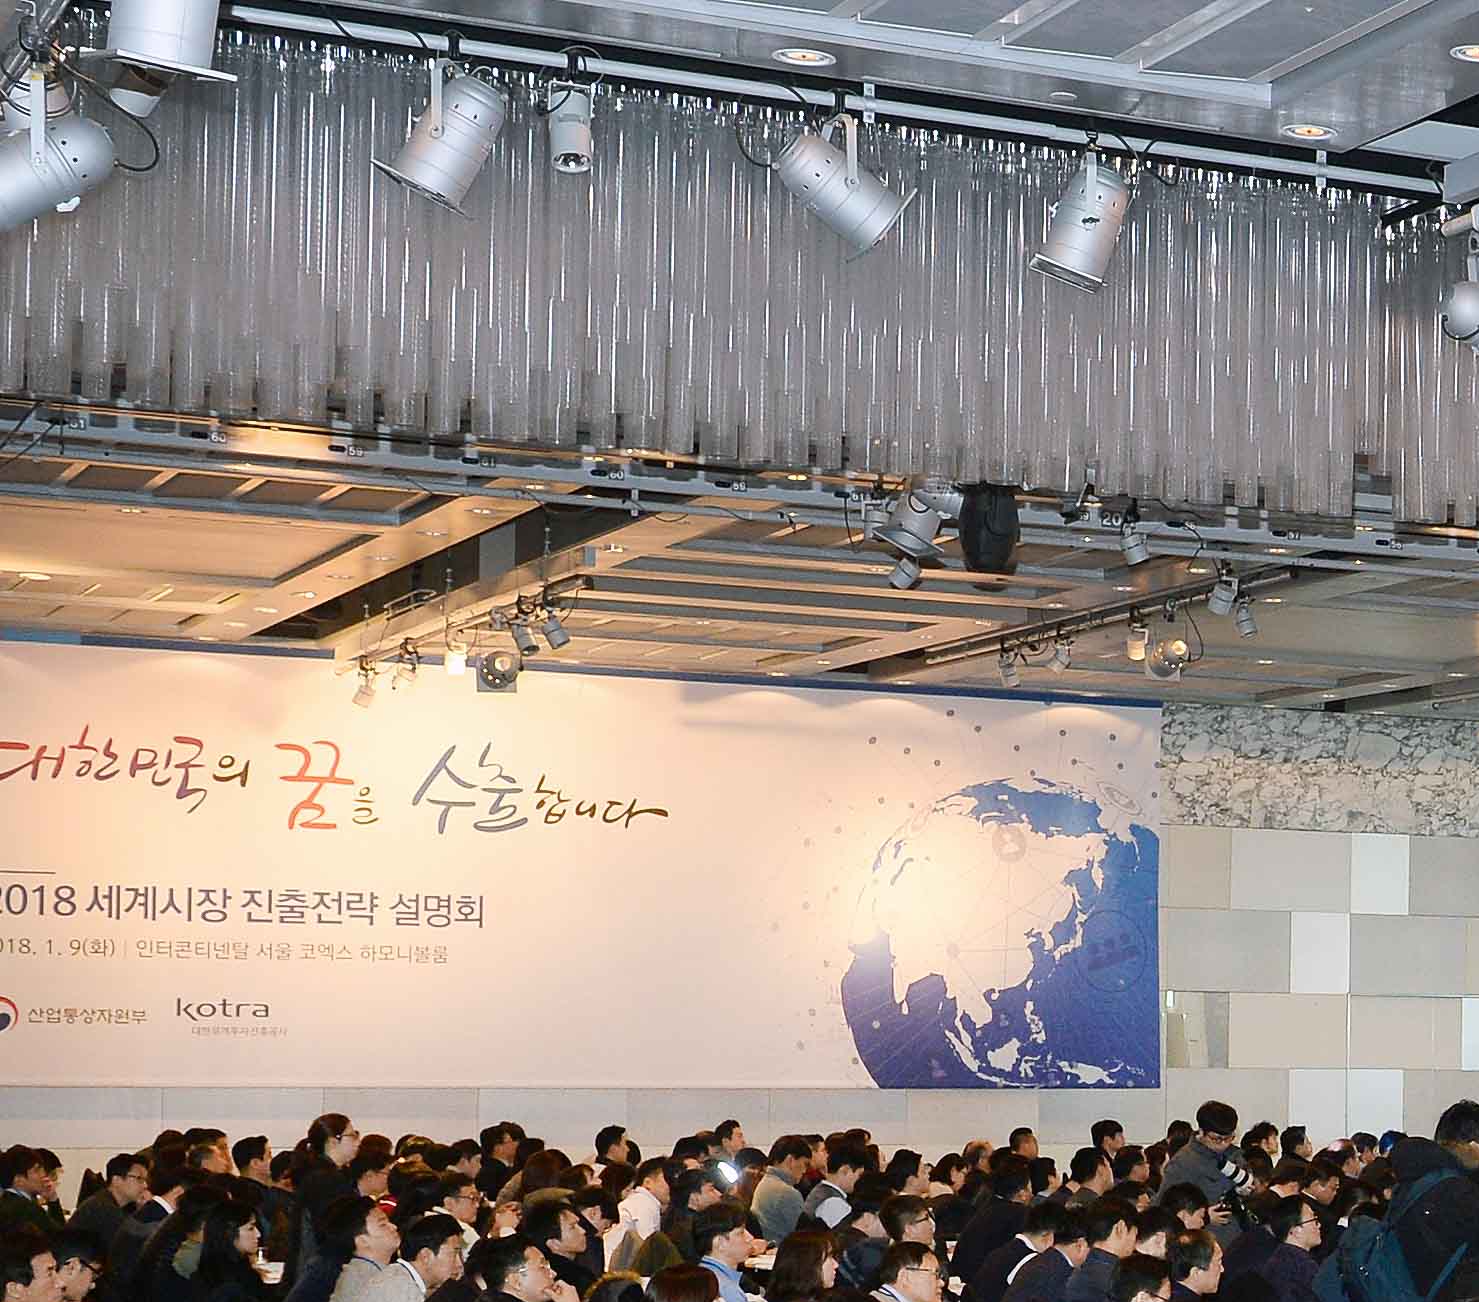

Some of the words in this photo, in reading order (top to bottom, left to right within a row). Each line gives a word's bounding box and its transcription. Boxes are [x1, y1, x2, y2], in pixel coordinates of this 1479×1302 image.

[1101, 511, 1122, 528] 20
[0, 724, 250, 814] 대한민국의
[274, 740, 379, 830] 꿈을
[412, 741, 668, 835] 수출합니다
[0, 884, 76, 917] 018
[86, 885, 232, 922] 세계시장
[240, 888, 379, 926] 진출전략
[389, 892, 486, 929] 설명회
[48, 939, 62, 956] 1.
[69, 938, 116, 958] 9(화)
[136, 938, 249, 960] 인터콘티넨탈
[256, 942, 292, 961] 서울
[299, 942, 353, 962] 코엑스
[360, 944, 449, 965] 하모니볼룸
[28, 1006, 149, 1025] 산업통상자원부
[175, 997, 270, 1022] kotra
